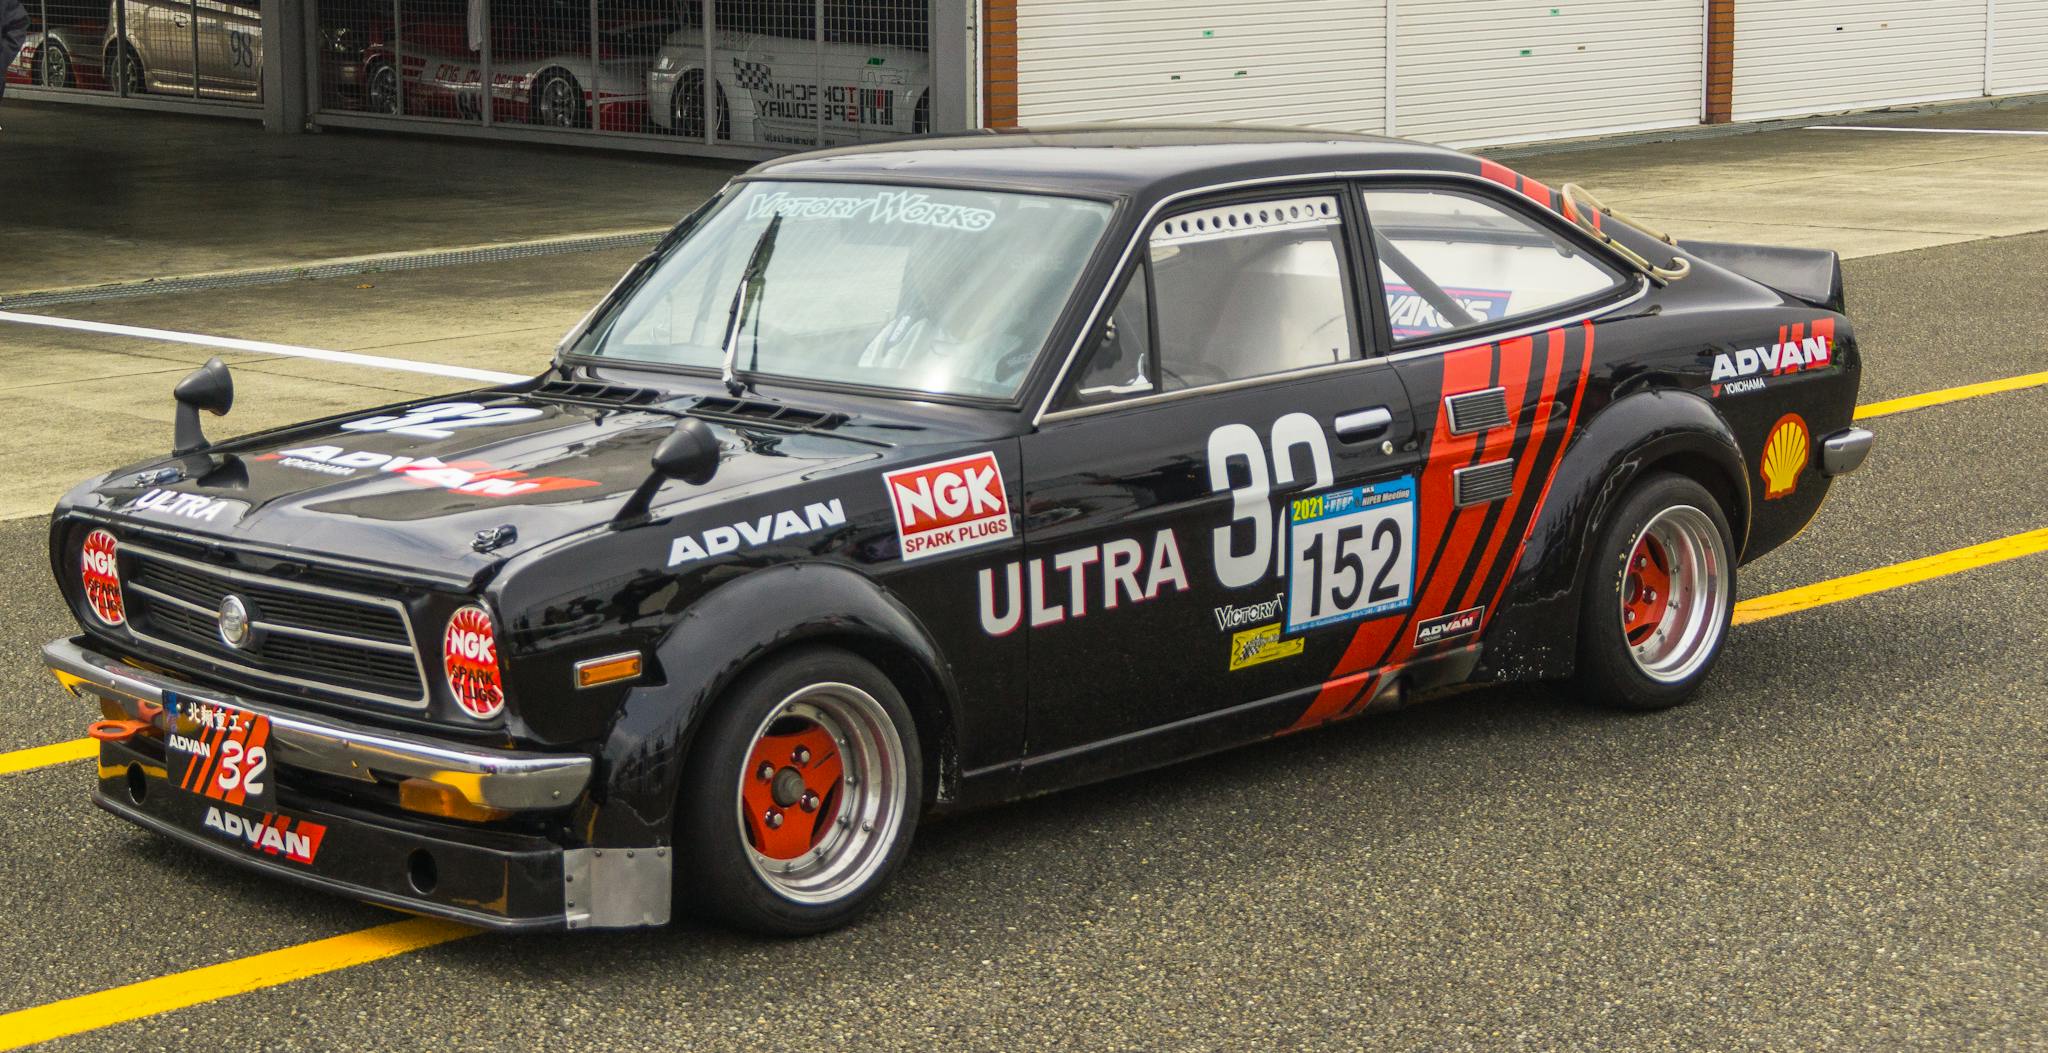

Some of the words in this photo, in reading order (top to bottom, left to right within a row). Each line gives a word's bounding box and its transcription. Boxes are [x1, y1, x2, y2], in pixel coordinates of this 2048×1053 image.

[231, 30, 253, 68] 98
[1711, 336, 1827, 381] ADVAN
[1724, 378, 1766, 395] YOKOHAMA
[340, 402, 543, 439] 32
[278, 445, 541, 496] ADVAN
[137, 488, 228, 522] ULTRA
[896, 464, 1002, 526] NGK
[1293, 496, 1324, 521] 2021
[667, 498, 847, 567] ADVAN
[905, 530, 956, 553] SPARK
[958, 518, 1008, 543] PLUGS
[978, 527, 1190, 638] ULTRA
[1302, 516, 1401, 618] 152
[451, 628, 494, 663] NGK
[1419, 616, 1474, 638] ADVAN
[452, 665, 495, 685] SPARK
[169, 734, 211, 758] ADVAN
[218, 740, 267, 795] 32
[204, 806, 311, 859] ADVAN
